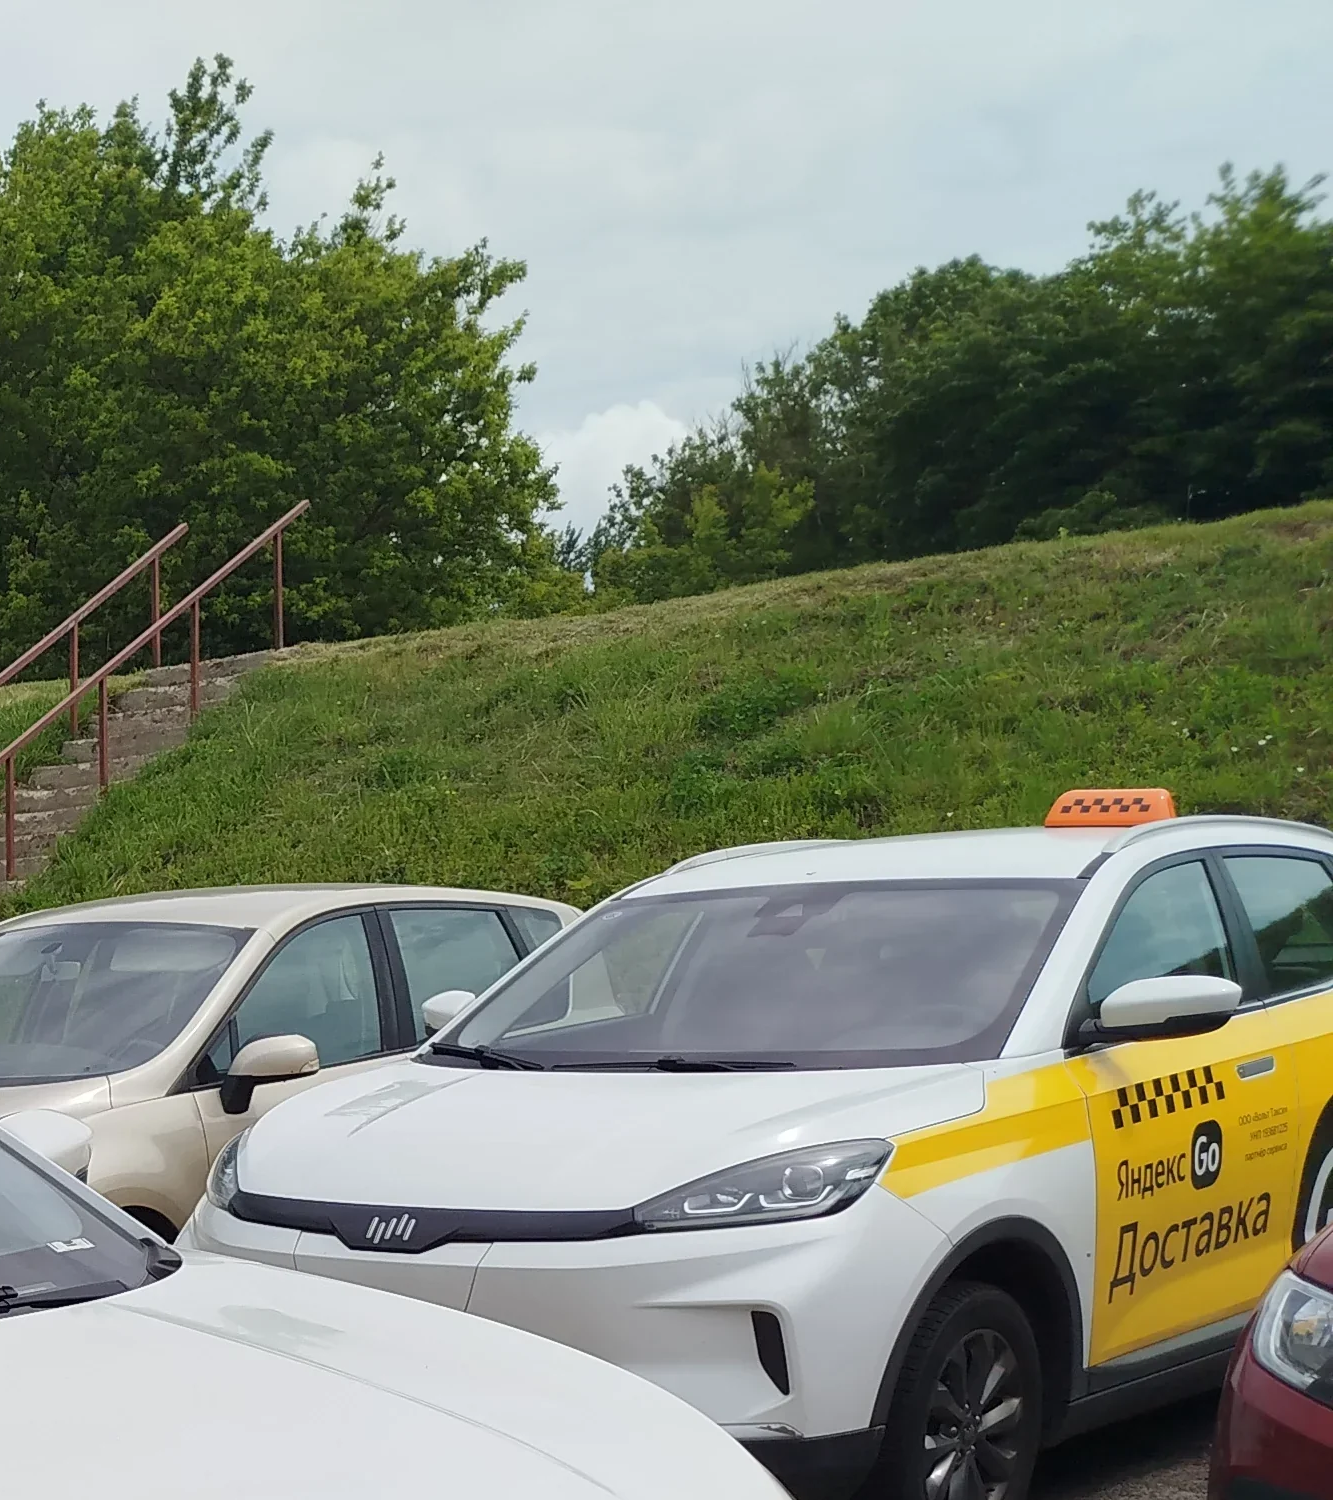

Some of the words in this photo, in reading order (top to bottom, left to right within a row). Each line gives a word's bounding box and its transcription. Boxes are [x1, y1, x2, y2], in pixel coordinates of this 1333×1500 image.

[1117, 1152, 1186, 1201] Яндекс
[1194, 1135, 1219, 1176] Go
[1108, 1191, 1271, 1305] Доставка
